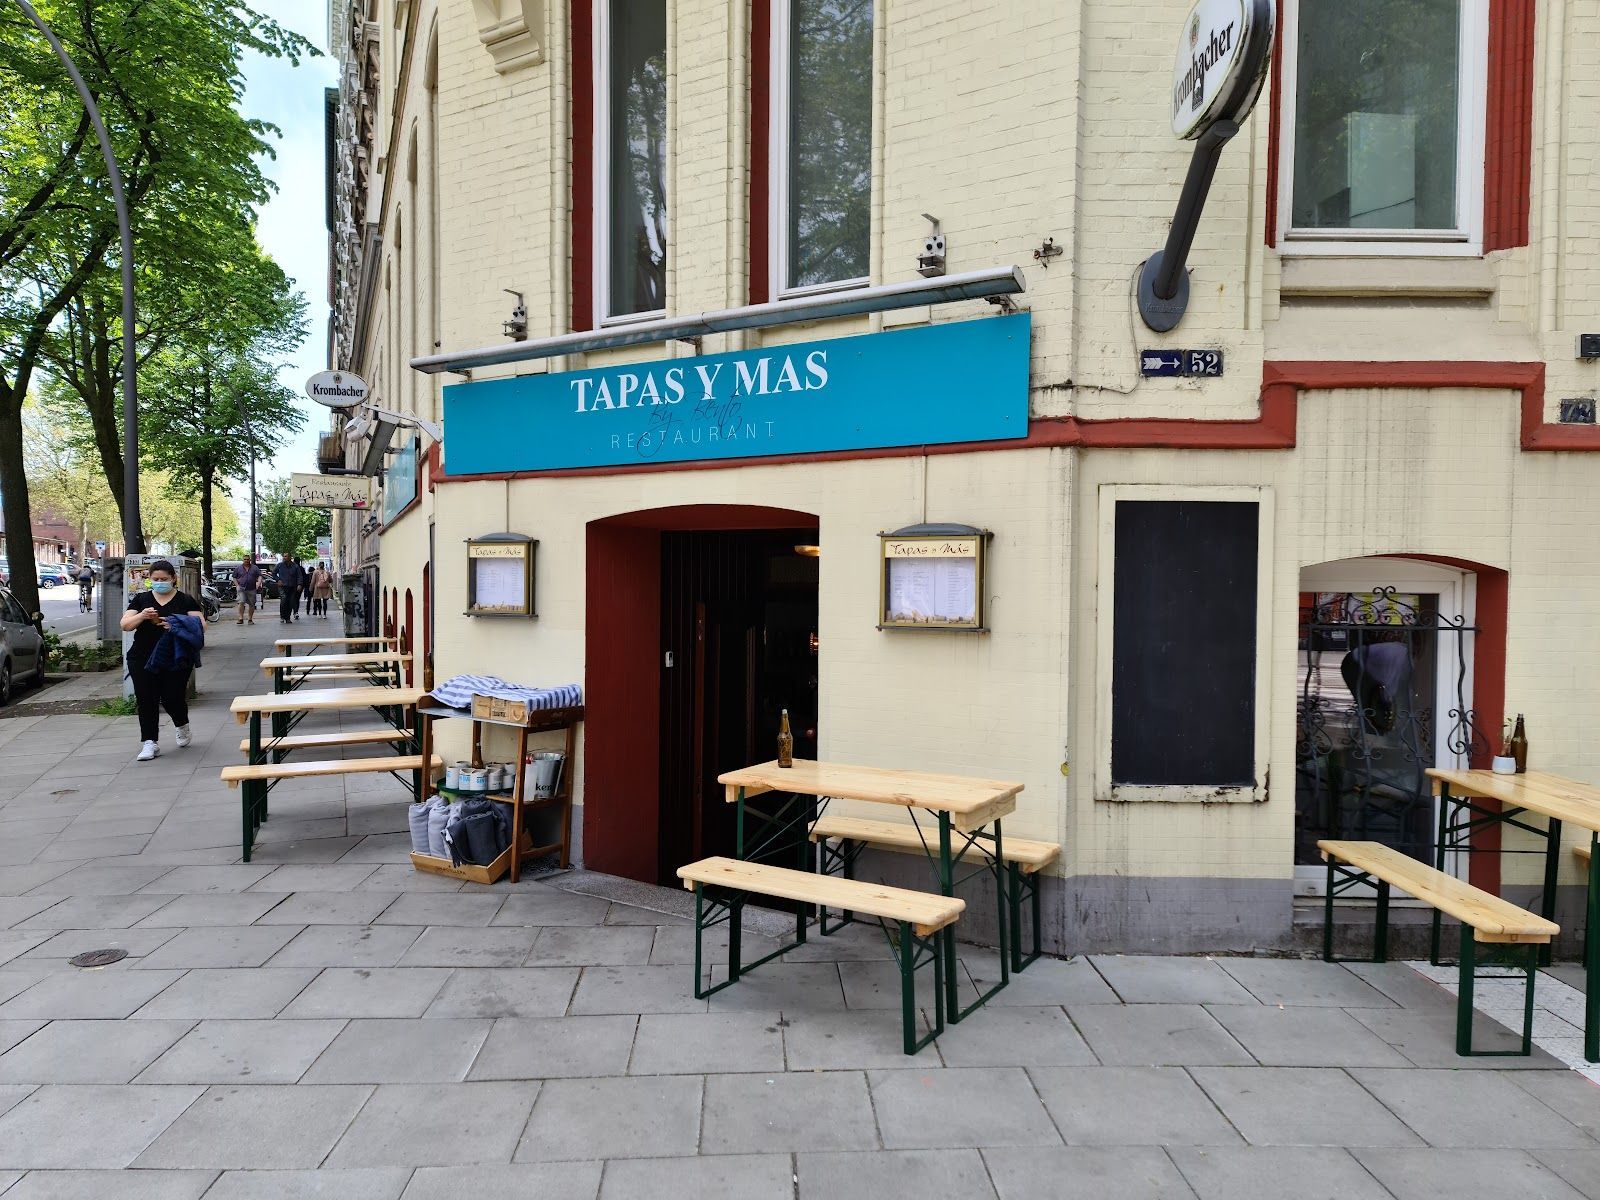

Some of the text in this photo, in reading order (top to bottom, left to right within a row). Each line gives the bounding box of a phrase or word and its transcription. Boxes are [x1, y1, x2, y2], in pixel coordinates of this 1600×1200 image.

[1173, 20, 1234, 120] Krombacher
[1191, 352, 1218, 374] 52
[313, 384, 364, 397] Krombacher
[570, 350, 830, 413] TAPAS Y MAS
[611, 421, 775, 449] RESTAURANT
[295, 485, 331, 502] Tapas
[891, 544, 928, 556] Tapas
[940, 543, 969, 554] Más
